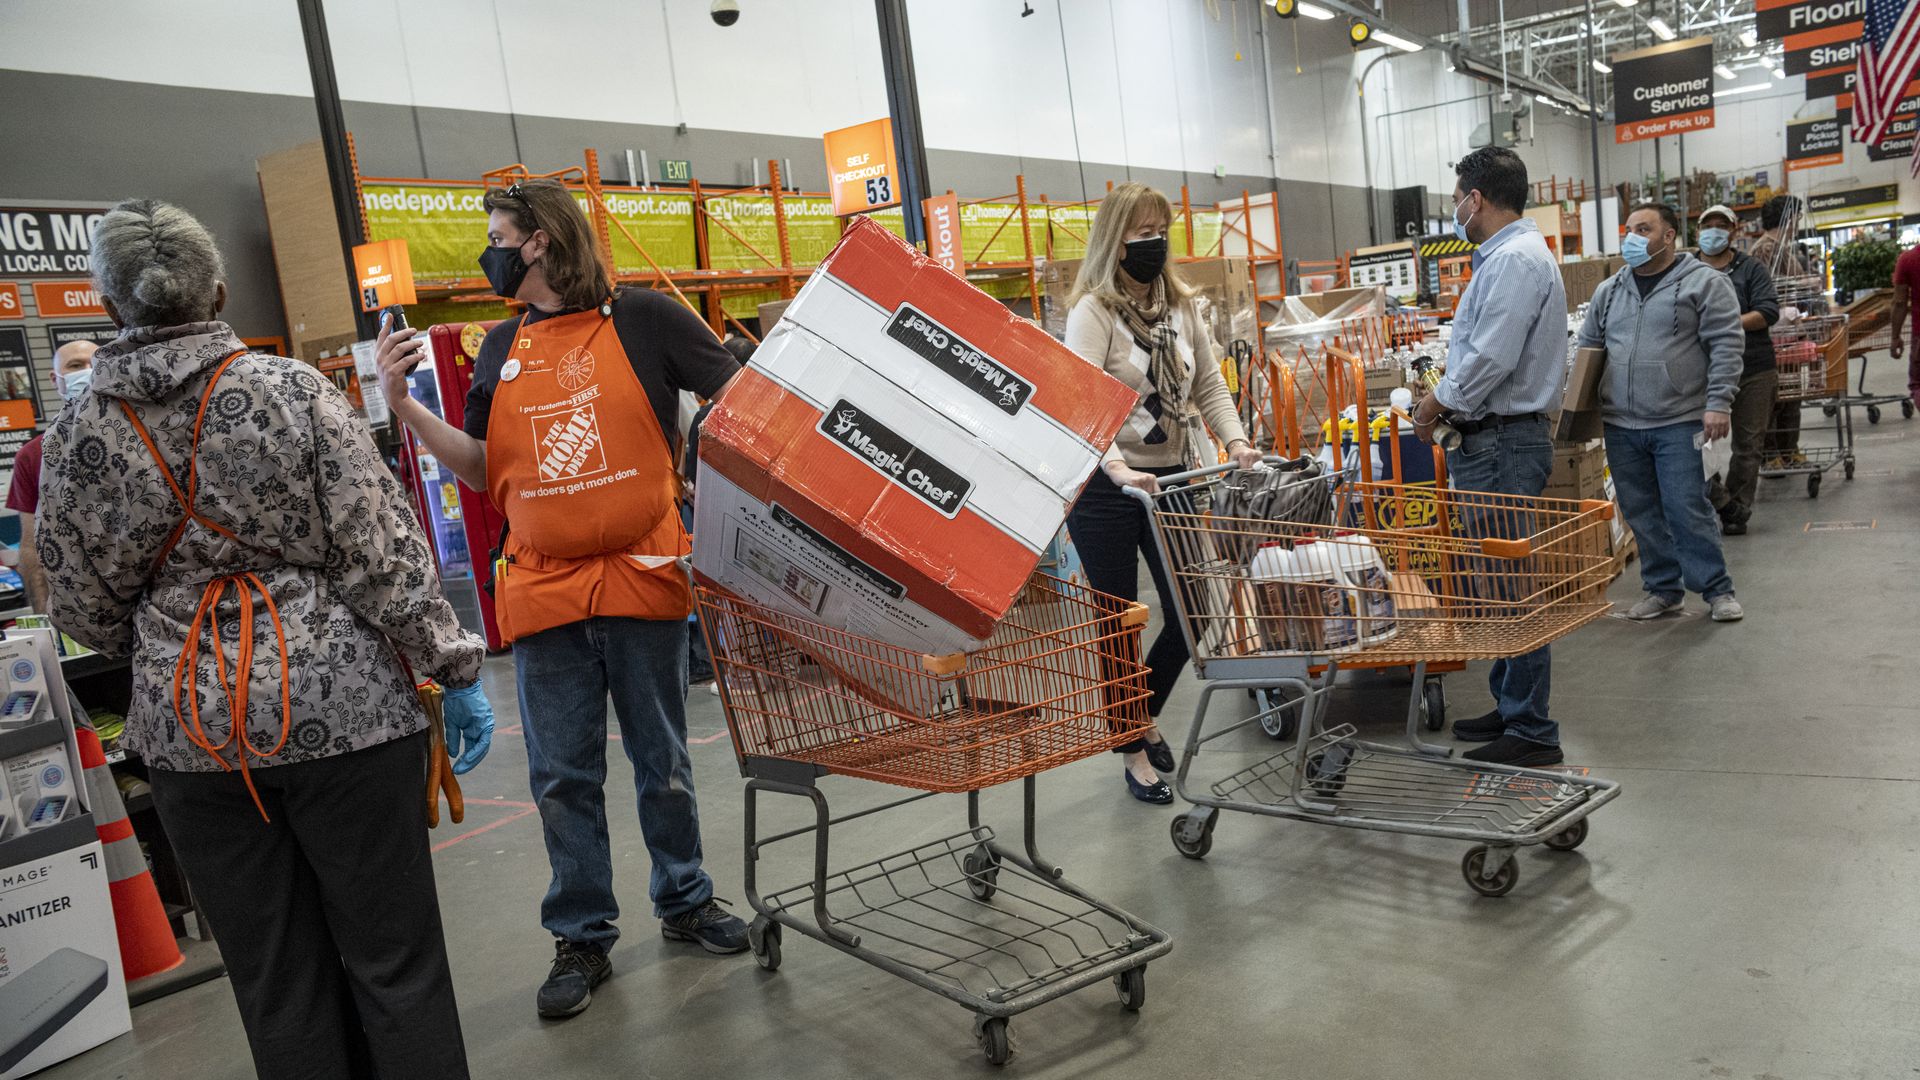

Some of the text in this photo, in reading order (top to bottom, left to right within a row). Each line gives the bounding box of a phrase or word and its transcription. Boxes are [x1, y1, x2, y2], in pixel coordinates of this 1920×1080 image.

[1633, 78, 1709, 101] Customer
[1650, 94, 1709, 114] Service
[1637, 115, 1710, 135] Order Pick Up
[1811, 121, 1838, 132] Order
[1801, 140, 1839, 152] Lockers
[1806, 130, 1839, 142] Pickup
[667, 161, 688, 179] EXIT
[847, 153, 870, 167] SELF
[835, 163, 887, 184] CHECKOUT
[866, 176, 890, 205] 53
[1811, 197, 1846, 209] Garden
[4, 254, 93, 273] LOCAL CO
[367, 265, 382, 275] SELF
[361, 273, 393, 288] CHECKOUT
[363, 288, 379, 309] 54
[57, 332, 96, 342] HONORING
[902, 315, 1006, 389] Magic Chef
[524, 404, 536, 413] put
[537, 399, 573, 412] customers
[572, 385, 600, 406] FIRST
[540, 408, 594, 480] HOME
[541, 420, 565, 448] THE
[565, 429, 599, 476] DEPOT
[847, 428, 953, 505] Magic Chef
[519, 467, 640, 499] How doers get more done.
[794, 528, 895, 594] Magic Chef
[760, 518, 778, 534] Cu.
[781, 533, 797, 547] Ft.
[799, 545, 852, 586] Compact
[854, 581, 932, 629] Refrigerator
[3, 866, 49, 888] MAGE
